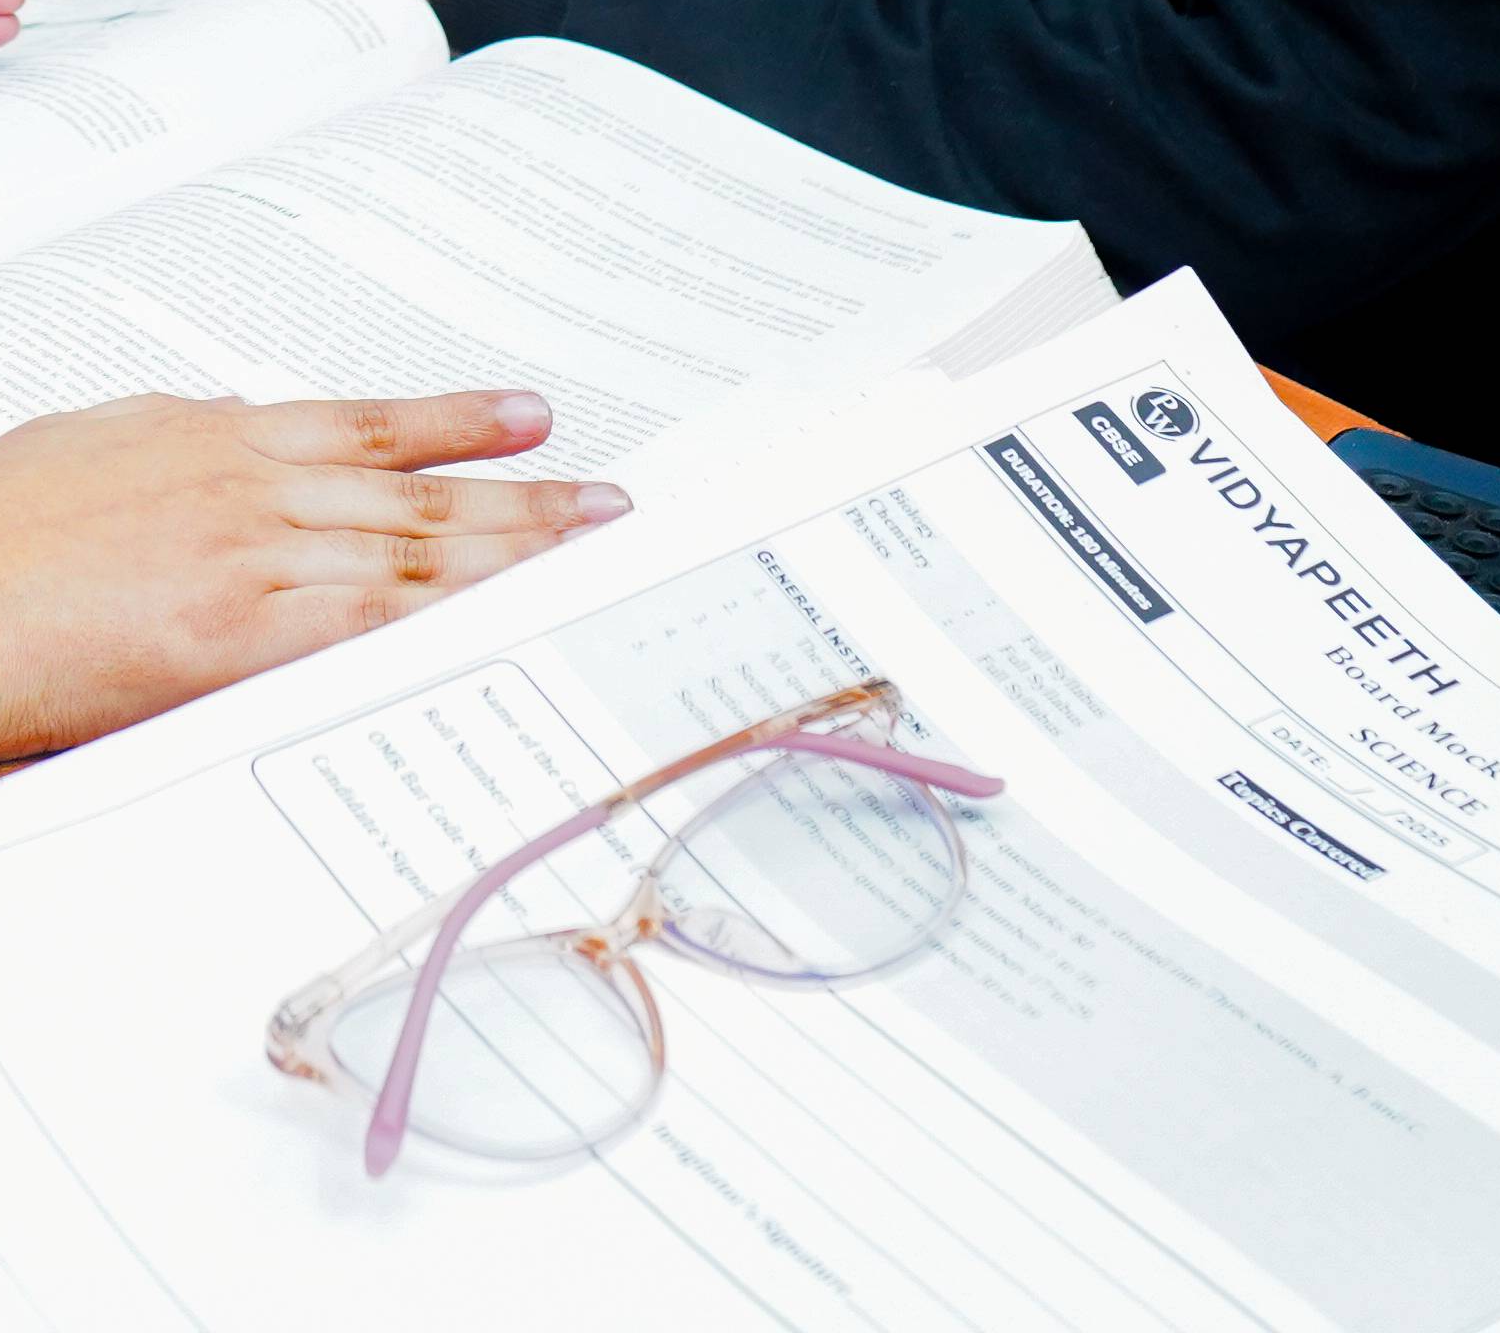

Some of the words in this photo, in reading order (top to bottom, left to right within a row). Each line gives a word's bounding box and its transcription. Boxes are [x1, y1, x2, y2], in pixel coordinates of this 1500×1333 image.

[1090, 414, 1144, 469] CBSE
[1001, 446, 1077, 527] DURATION:
[1096, 549, 1154, 614] Minutes
[1189, 438, 1460, 697] VIDYAPEETH
[756, 548, 821, 625] GENERAL
[844, 506, 894, 559] Physics
[976, 653, 1007, 685] Full
[1004, 681, 1063, 738] Syllabus
[867, 496, 932, 571] Chemistry
[998, 643, 1029, 674] Full
[1028, 672, 1086, 729] Syllabus
[888, 487, 938, 540] Biology
[1021, 633, 1051, 664] Full
[1049, 661, 1108, 719] Syllabus
[423, 706, 458, 742] Roll
[477, 683, 521, 731] Name
[517, 730, 539, 751] of
[532, 744, 562, 780] the
[1324, 645, 1420, 722] Board
[367, 729, 408, 774] OMR
[400, 770, 432, 805] Bar
[426, 800, 466, 847] Code
[1271, 726, 1332, 771] DATE:
[1349, 727, 1491, 818] SCIENCE
[311, 752, 391, 850] Candidate's
[1221, 771, 1292, 828] Topics
[1287, 814, 1388, 880] Covered
